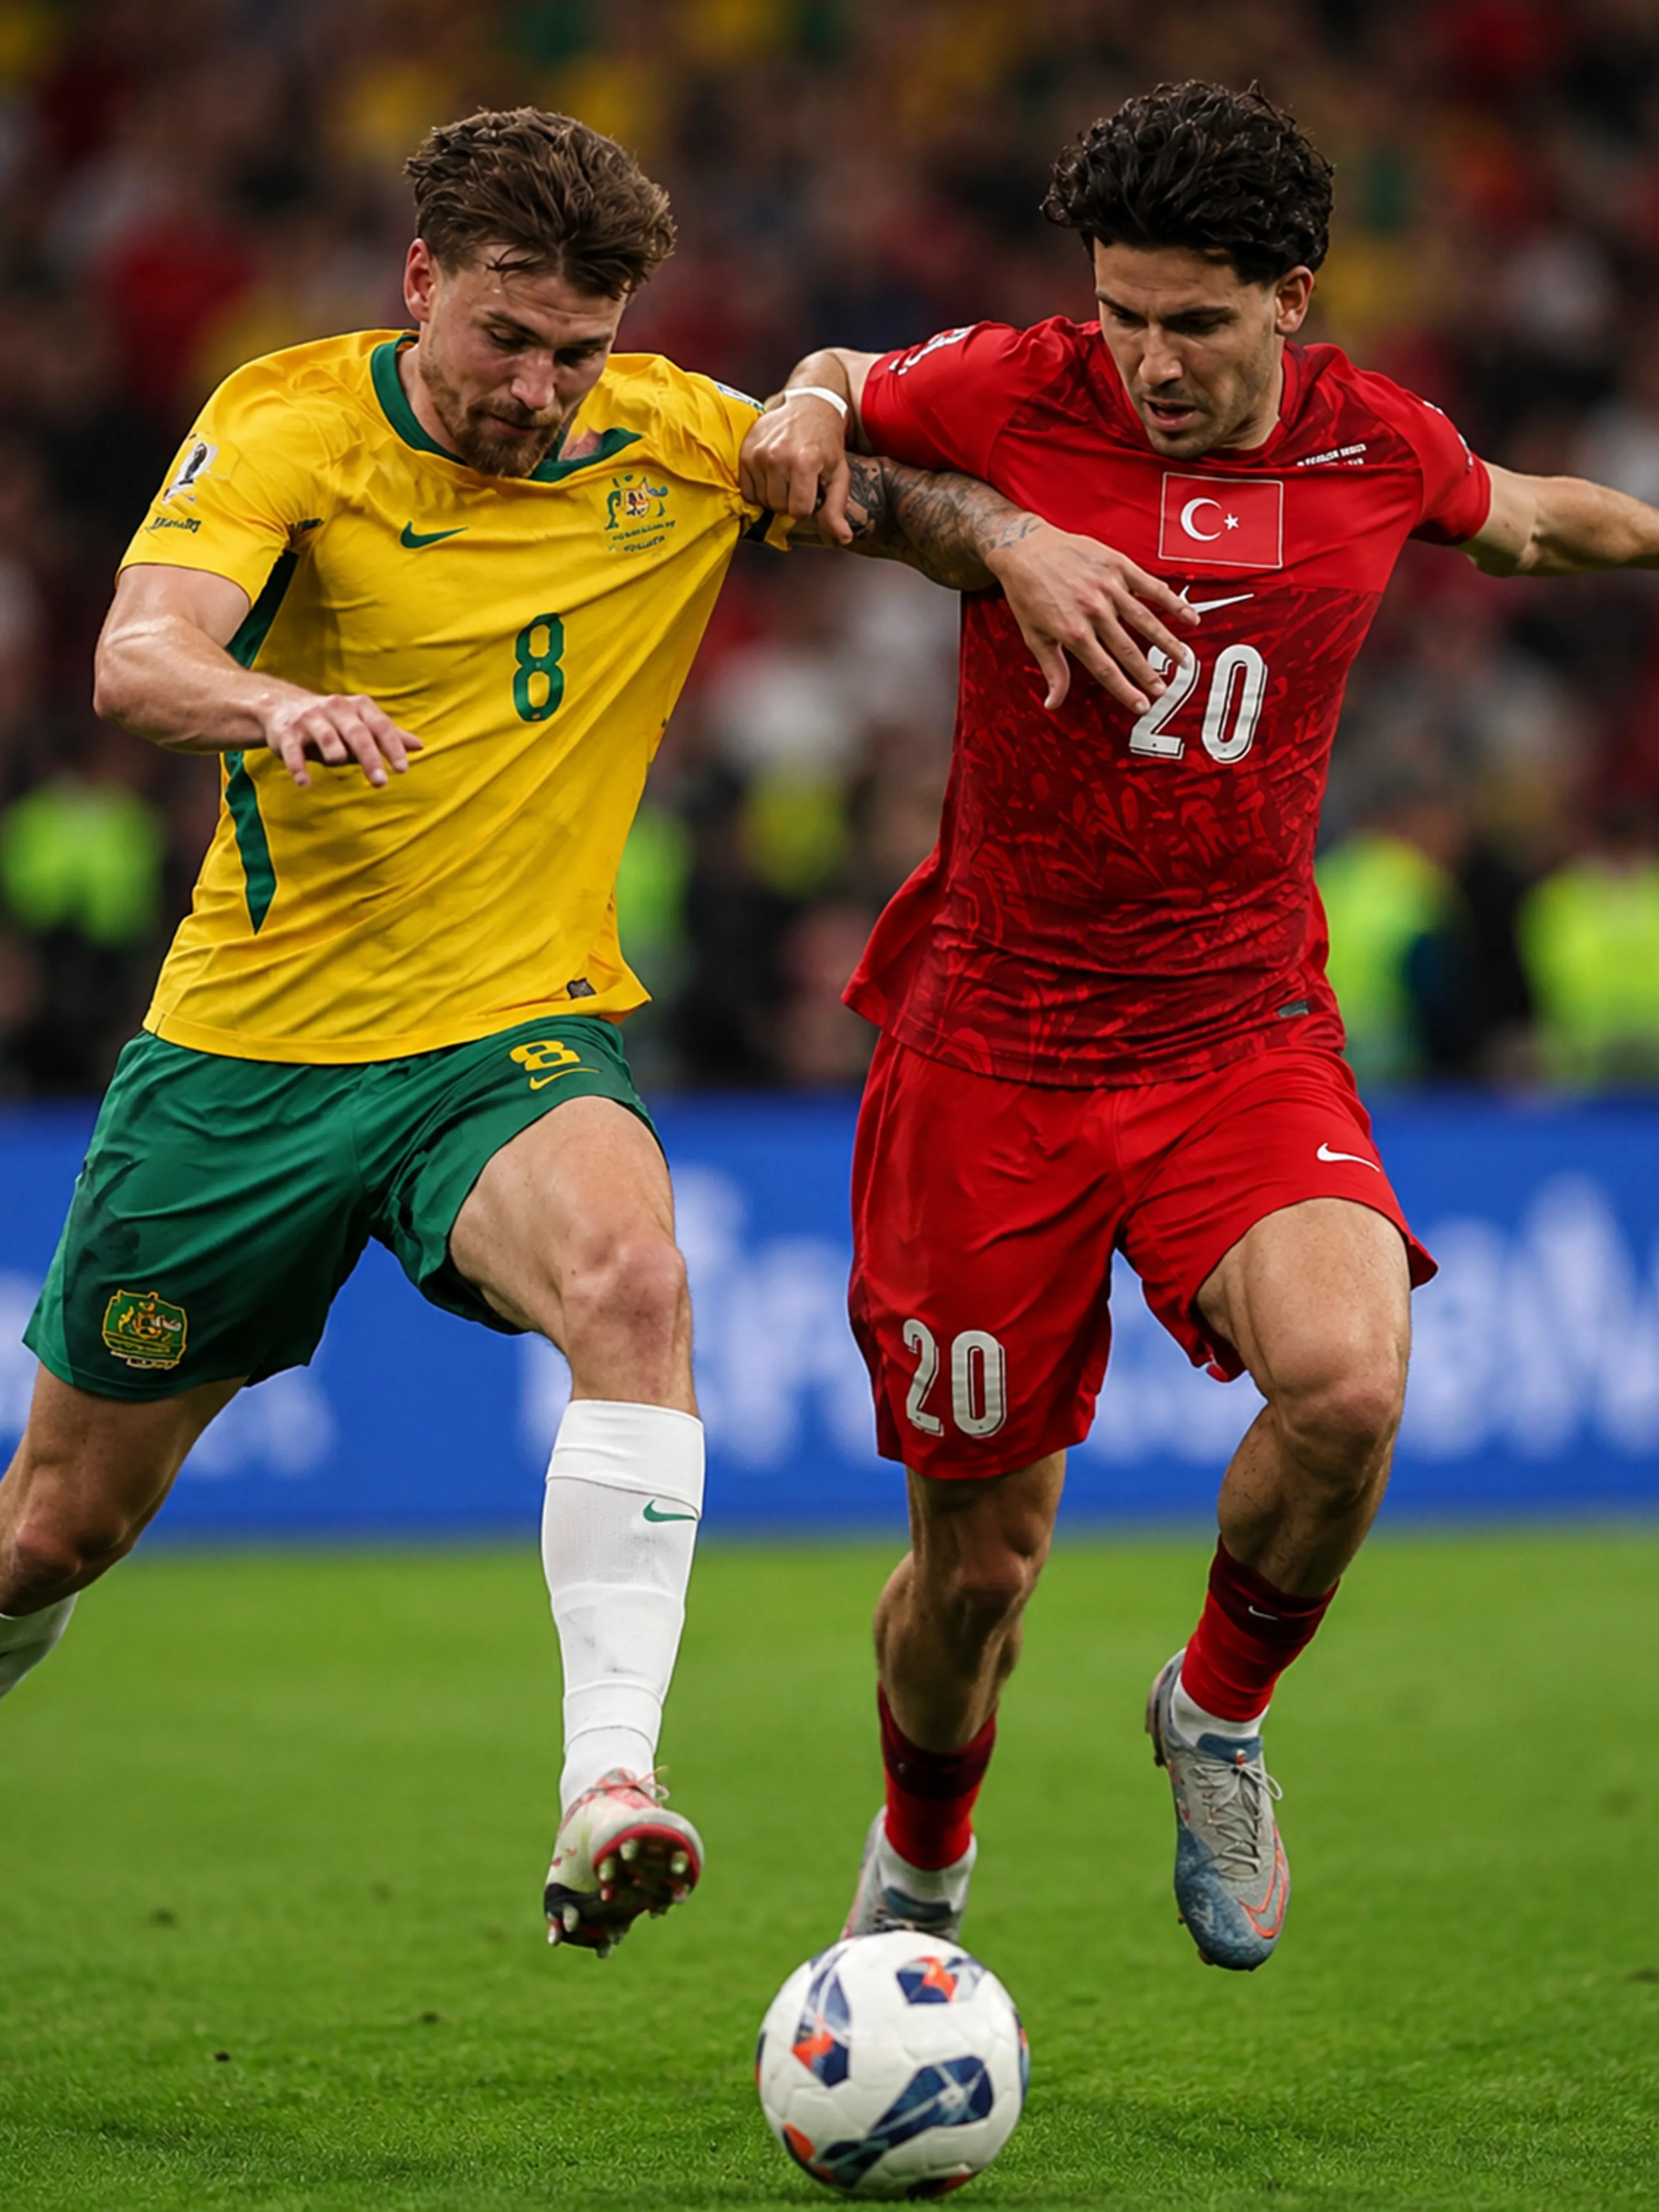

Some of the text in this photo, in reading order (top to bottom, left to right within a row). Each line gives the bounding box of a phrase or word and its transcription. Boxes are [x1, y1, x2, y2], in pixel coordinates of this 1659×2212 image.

[513, 612, 564, 723] 8
[1129, 641, 1268, 764] 20
[509, 1040, 581, 1071] 8
[902, 1318, 1006, 1439] 20
